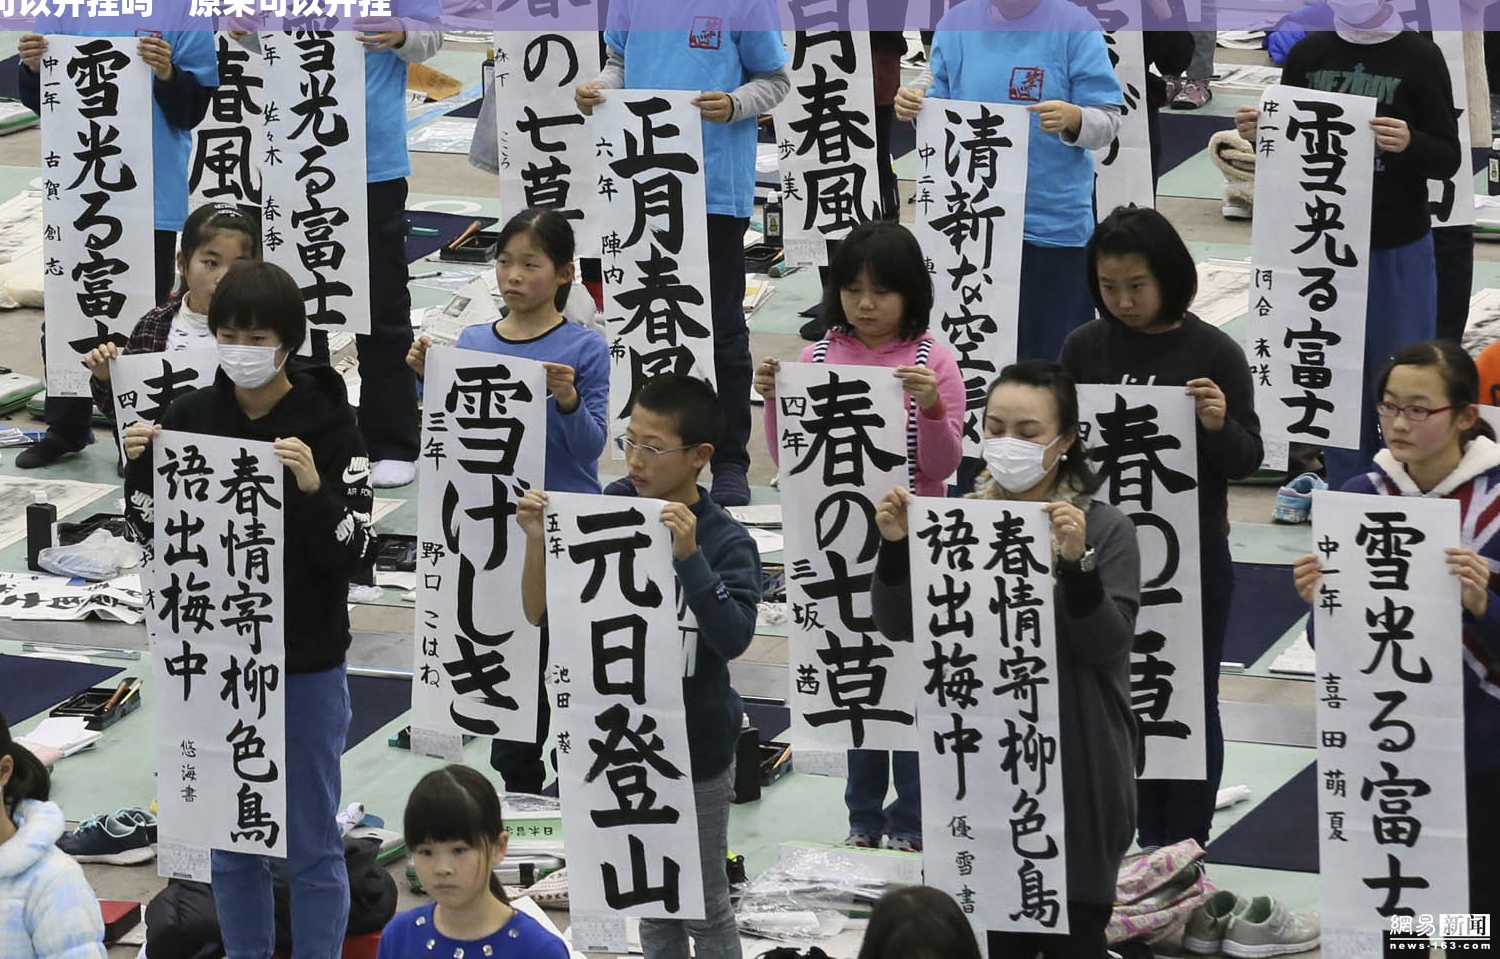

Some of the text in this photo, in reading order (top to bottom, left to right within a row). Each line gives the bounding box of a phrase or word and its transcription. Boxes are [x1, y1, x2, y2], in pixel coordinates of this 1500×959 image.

[41, 57, 62, 201] 中一年 古賀
[65, 39, 137, 364] 雪光る富士
[261, 100, 284, 166] 佐々木
[283, 8, 354, 326] 雪光る富士
[595, 136, 618, 202] 六年
[777, 140, 804, 202] 歩美
[915, 143, 934, 216] 中二年
[1258, 99, 1280, 158] 中一年
[1282, 101, 1358, 439] 雪光る富士
[419, 411, 448, 690] 三年 野口 こはね
[442, 364, 534, 736] 雪げしき
[780, 395, 809, 456] 四年
[788, 372, 916, 748] 春の七草
[157, 444, 215, 703] 語出梅中
[217, 447, 282, 850] 春情寄柳色鳥
[546, 512, 573, 710] 五年 池田
[567, 507, 687, 915] 元日登山
[917, 508, 984, 800] 語出梅中
[1317, 534, 1349, 842] 中一年 喜田萌夏
[1355, 511, 1433, 919] 雪光る富士
[984, 510, 1059, 929] 春情寄柳色鳥
[948, 815, 976, 915] 優雪書
